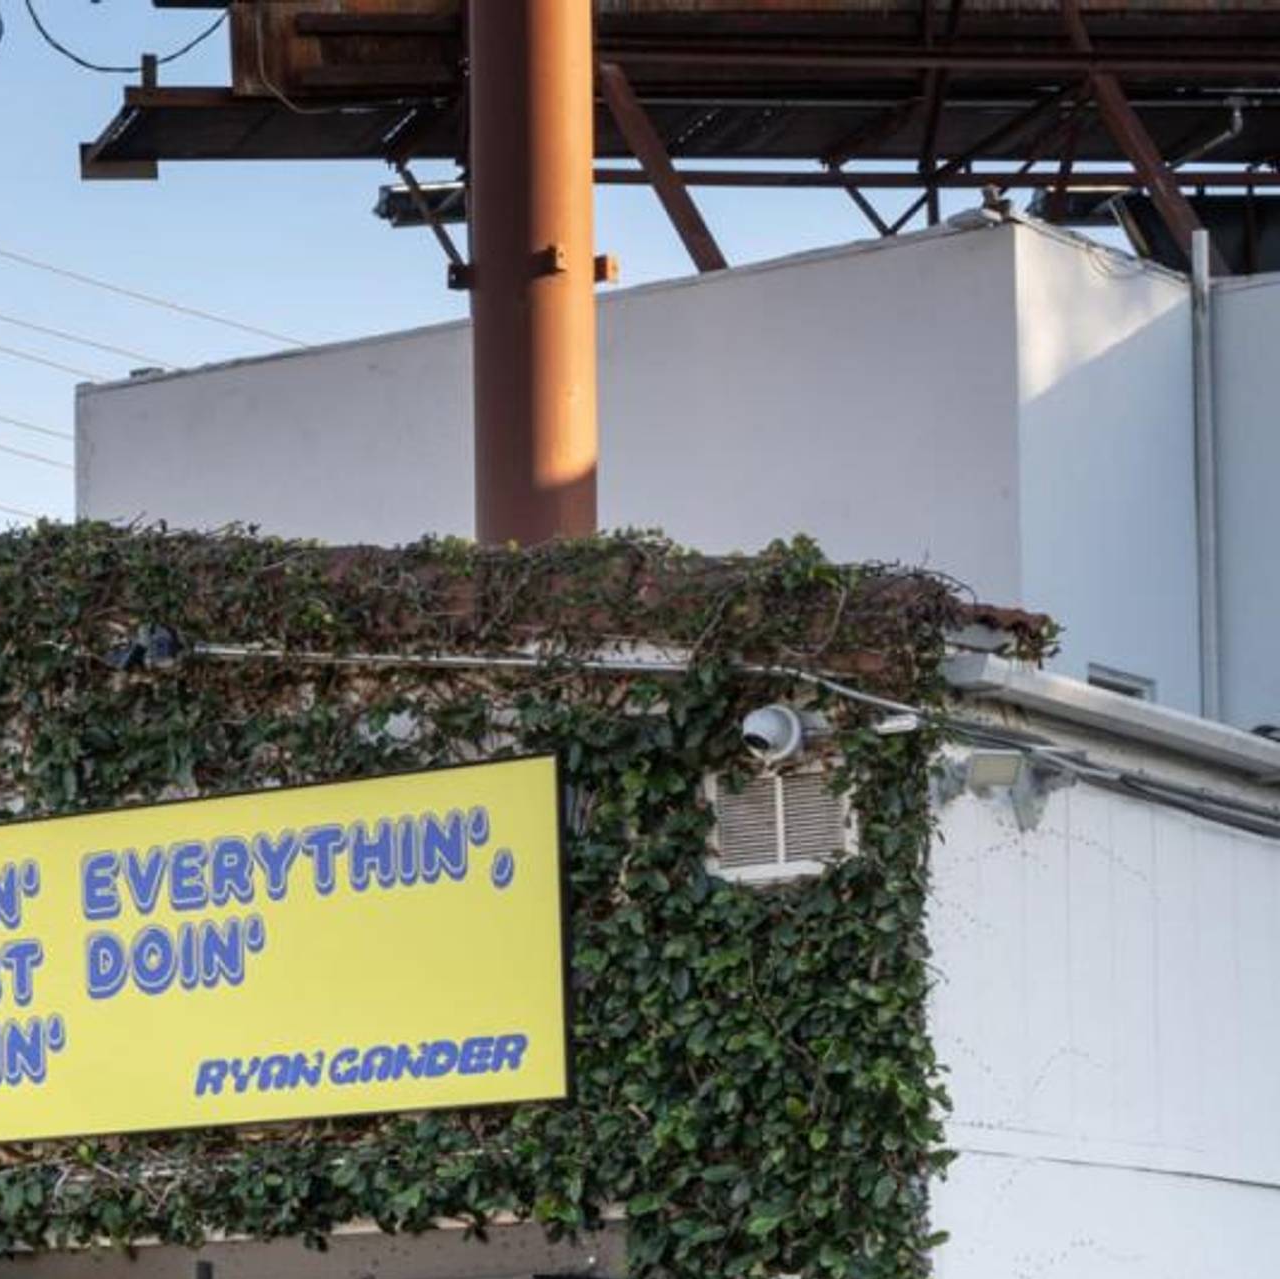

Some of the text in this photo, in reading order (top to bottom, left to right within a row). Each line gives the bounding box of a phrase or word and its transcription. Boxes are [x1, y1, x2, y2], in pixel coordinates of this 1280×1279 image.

[86, 916, 265, 1000] DOIN'
[195, 1034, 529, 1097] RYAN GANDER
